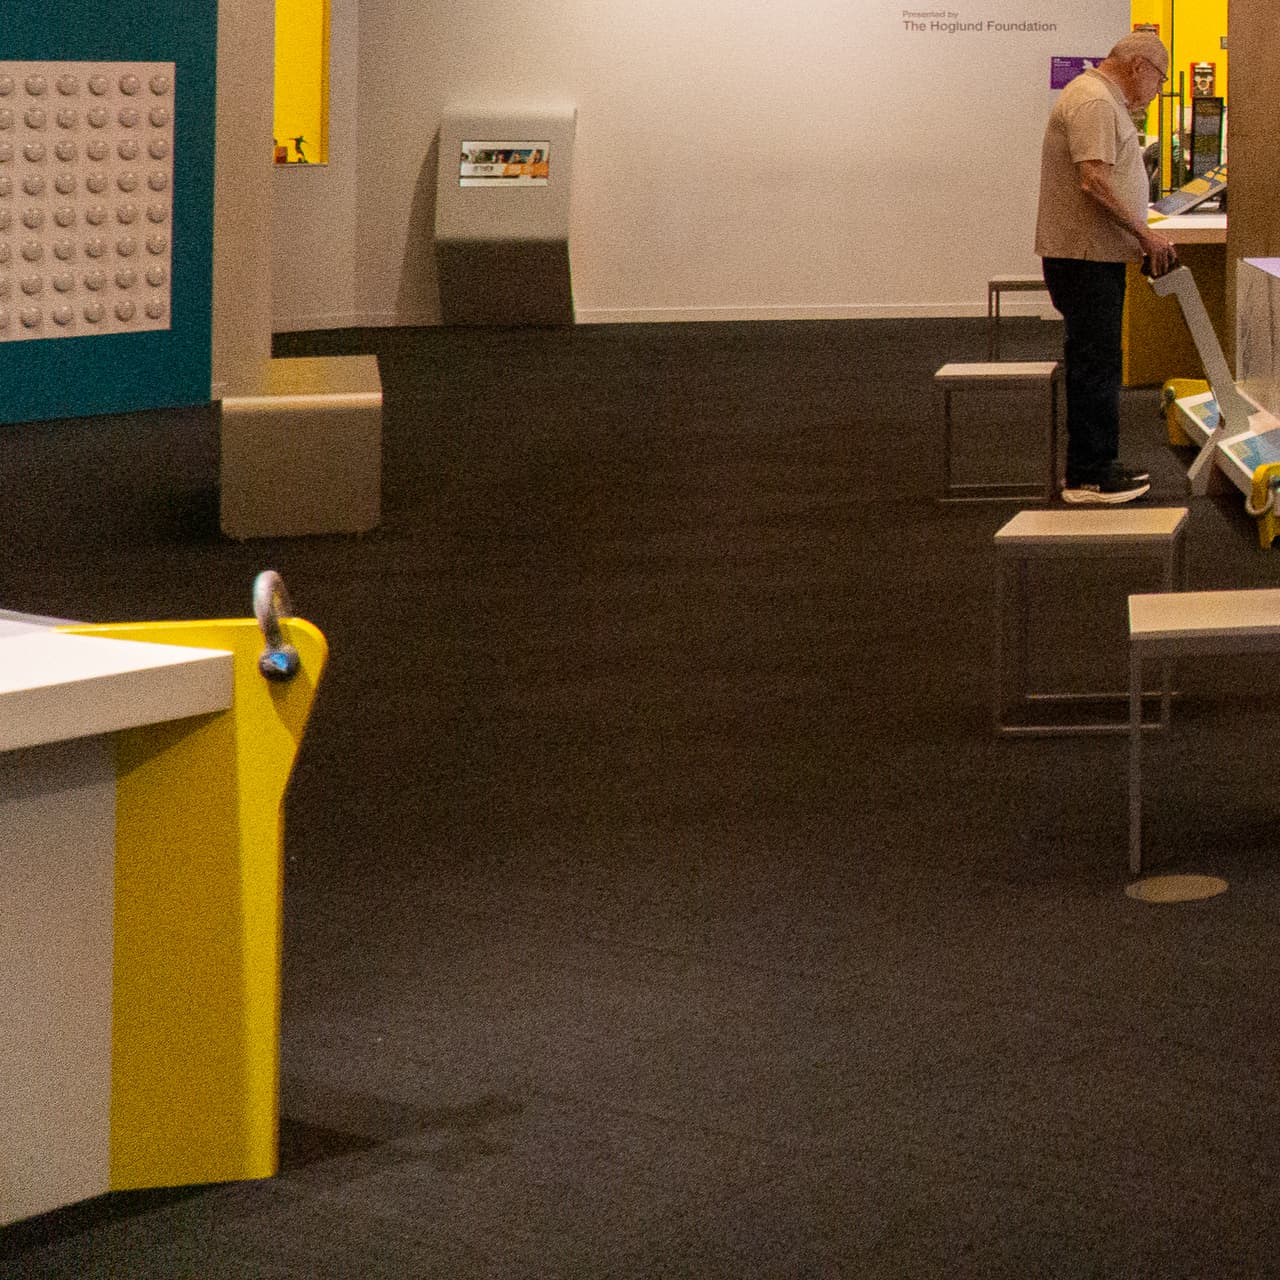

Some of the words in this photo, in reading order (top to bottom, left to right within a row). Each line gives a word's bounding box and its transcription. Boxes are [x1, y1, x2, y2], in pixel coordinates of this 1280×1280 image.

[902, 10, 946, 18] Presented
[947, 11, 959, 19] by
[903, 21, 926, 31] The
[929, 21, 983, 33] Hoglund
[987, 21, 1057, 31] Foundation
